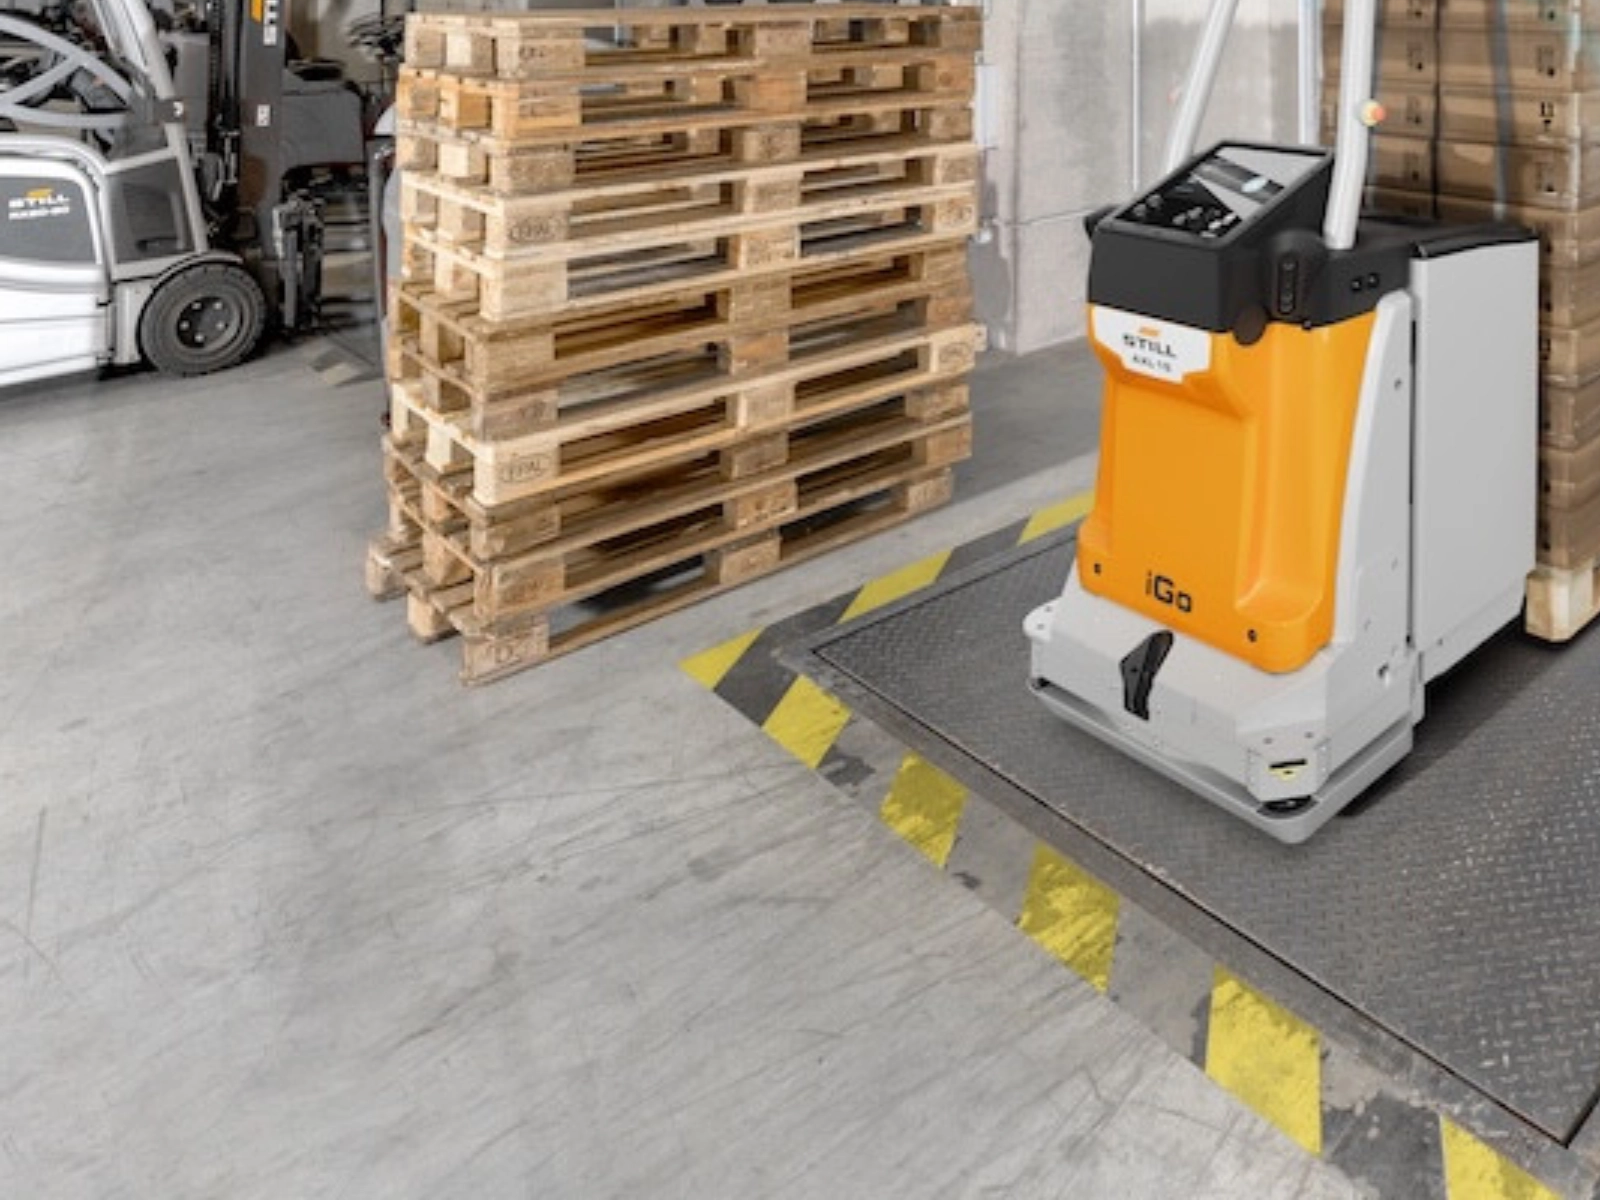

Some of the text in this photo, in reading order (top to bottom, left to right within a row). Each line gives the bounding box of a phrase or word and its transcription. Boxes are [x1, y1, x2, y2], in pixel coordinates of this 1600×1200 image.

[8, 194, 70, 209] STILL
[1122, 333, 1176, 358] STILL
[1145, 569, 1192, 613] iGo
